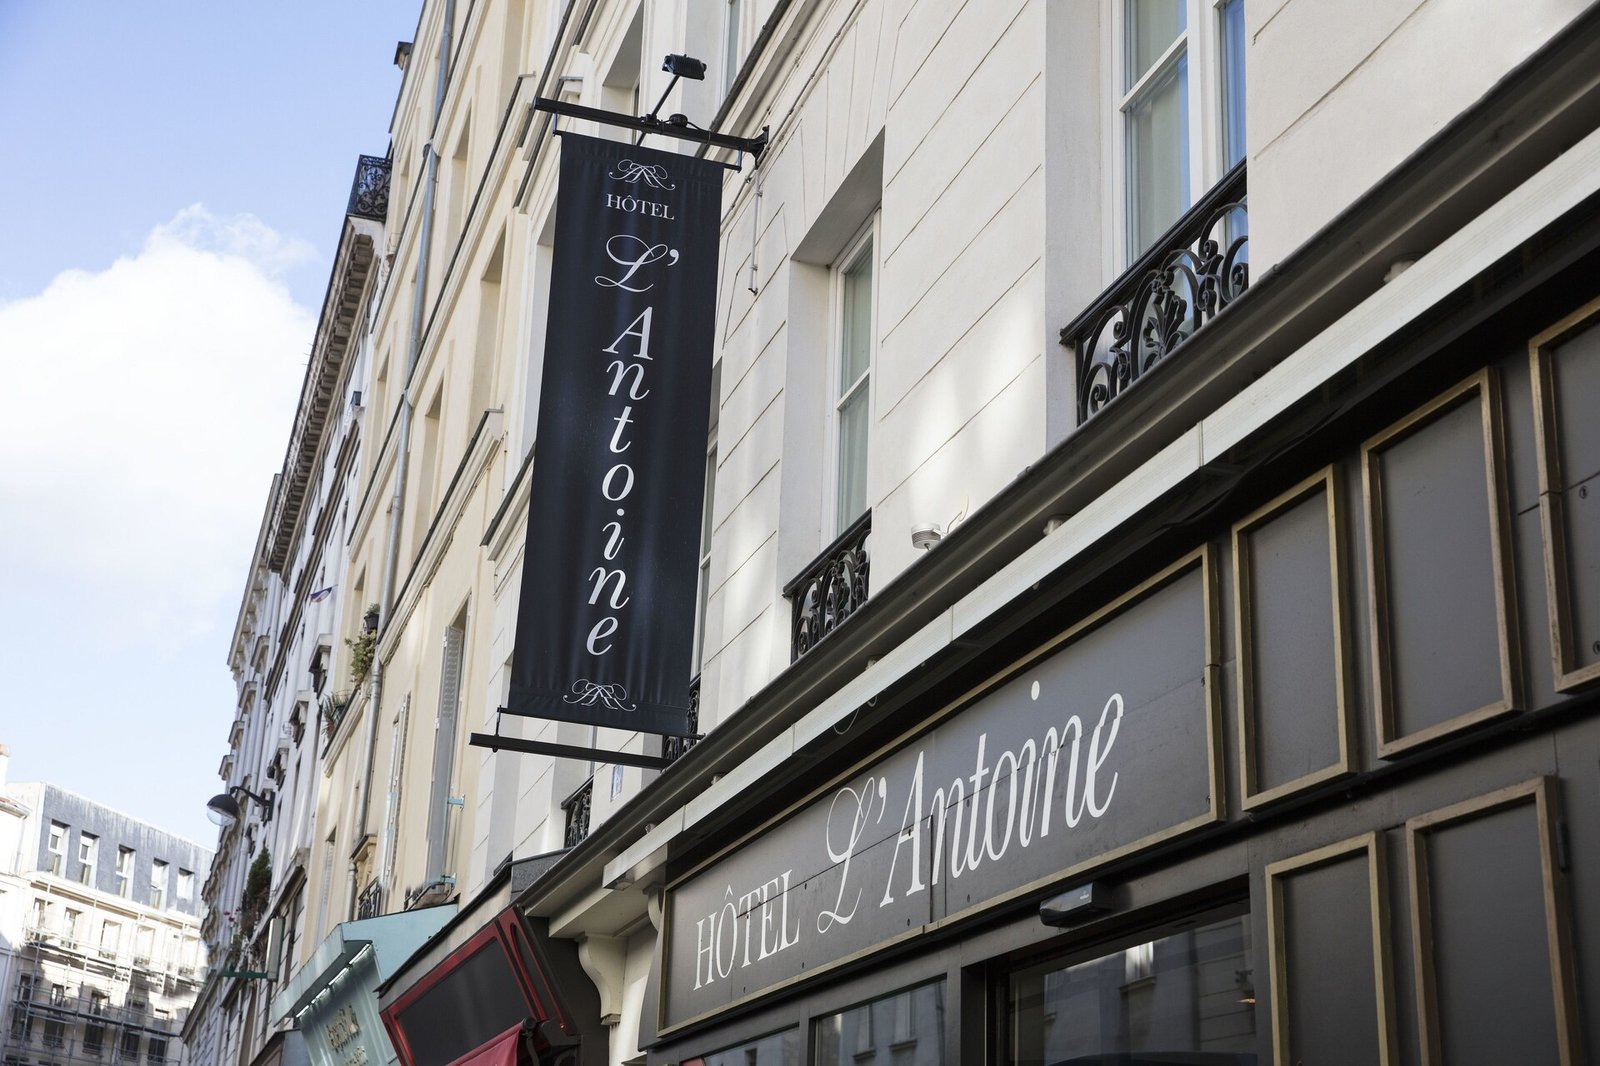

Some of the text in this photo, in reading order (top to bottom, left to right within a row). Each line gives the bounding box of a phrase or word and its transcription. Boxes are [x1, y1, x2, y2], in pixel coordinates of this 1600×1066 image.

[606, 194, 675, 220] HÔTEL
[693, 680, 1124, 991] HÔTEL L'Antoine
